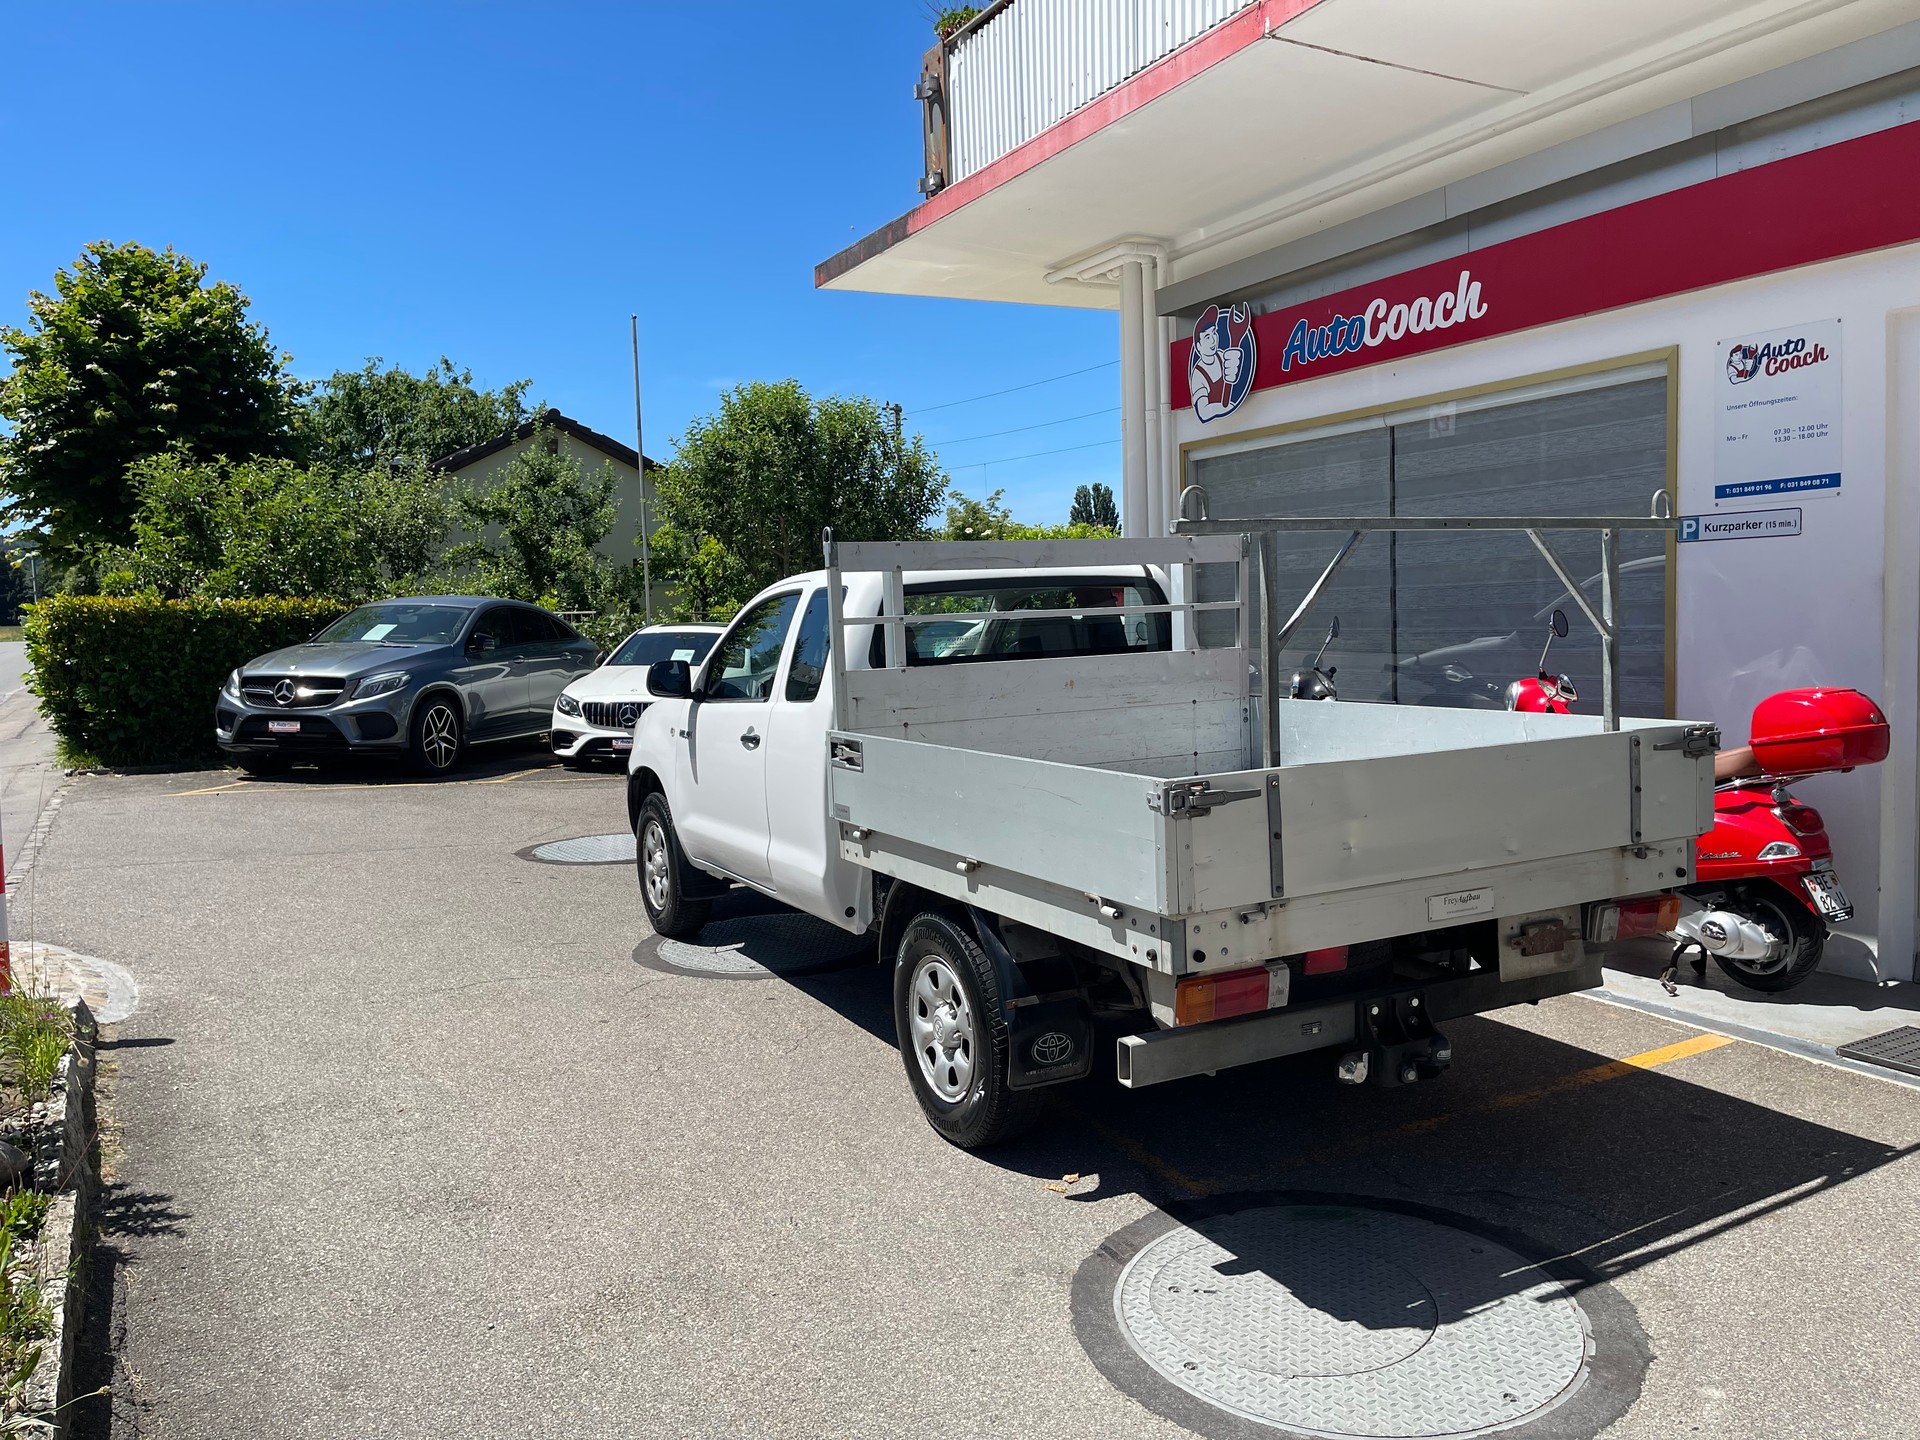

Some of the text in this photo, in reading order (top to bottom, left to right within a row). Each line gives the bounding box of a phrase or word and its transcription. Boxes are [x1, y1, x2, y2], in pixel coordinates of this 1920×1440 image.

[1758, 338, 1806, 365] Auto
[1765, 343, 1829, 376] Coach
[1726, 395, 1799, 411] Unsere Öffnungszeiten:
[1773, 428, 1791, 436] 07.30
[1798, 424, 1815, 432] 12.00
[1774, 435, 1791, 443] 13.30
[1798, 432, 1815, 440] 18.00
[1704, 520, 1763, 533] Kurzparker
[1765, 520, 1777, 530] (15
[1778, 519, 1797, 529] min.)
[1814, 875, 1832, 891] BE
